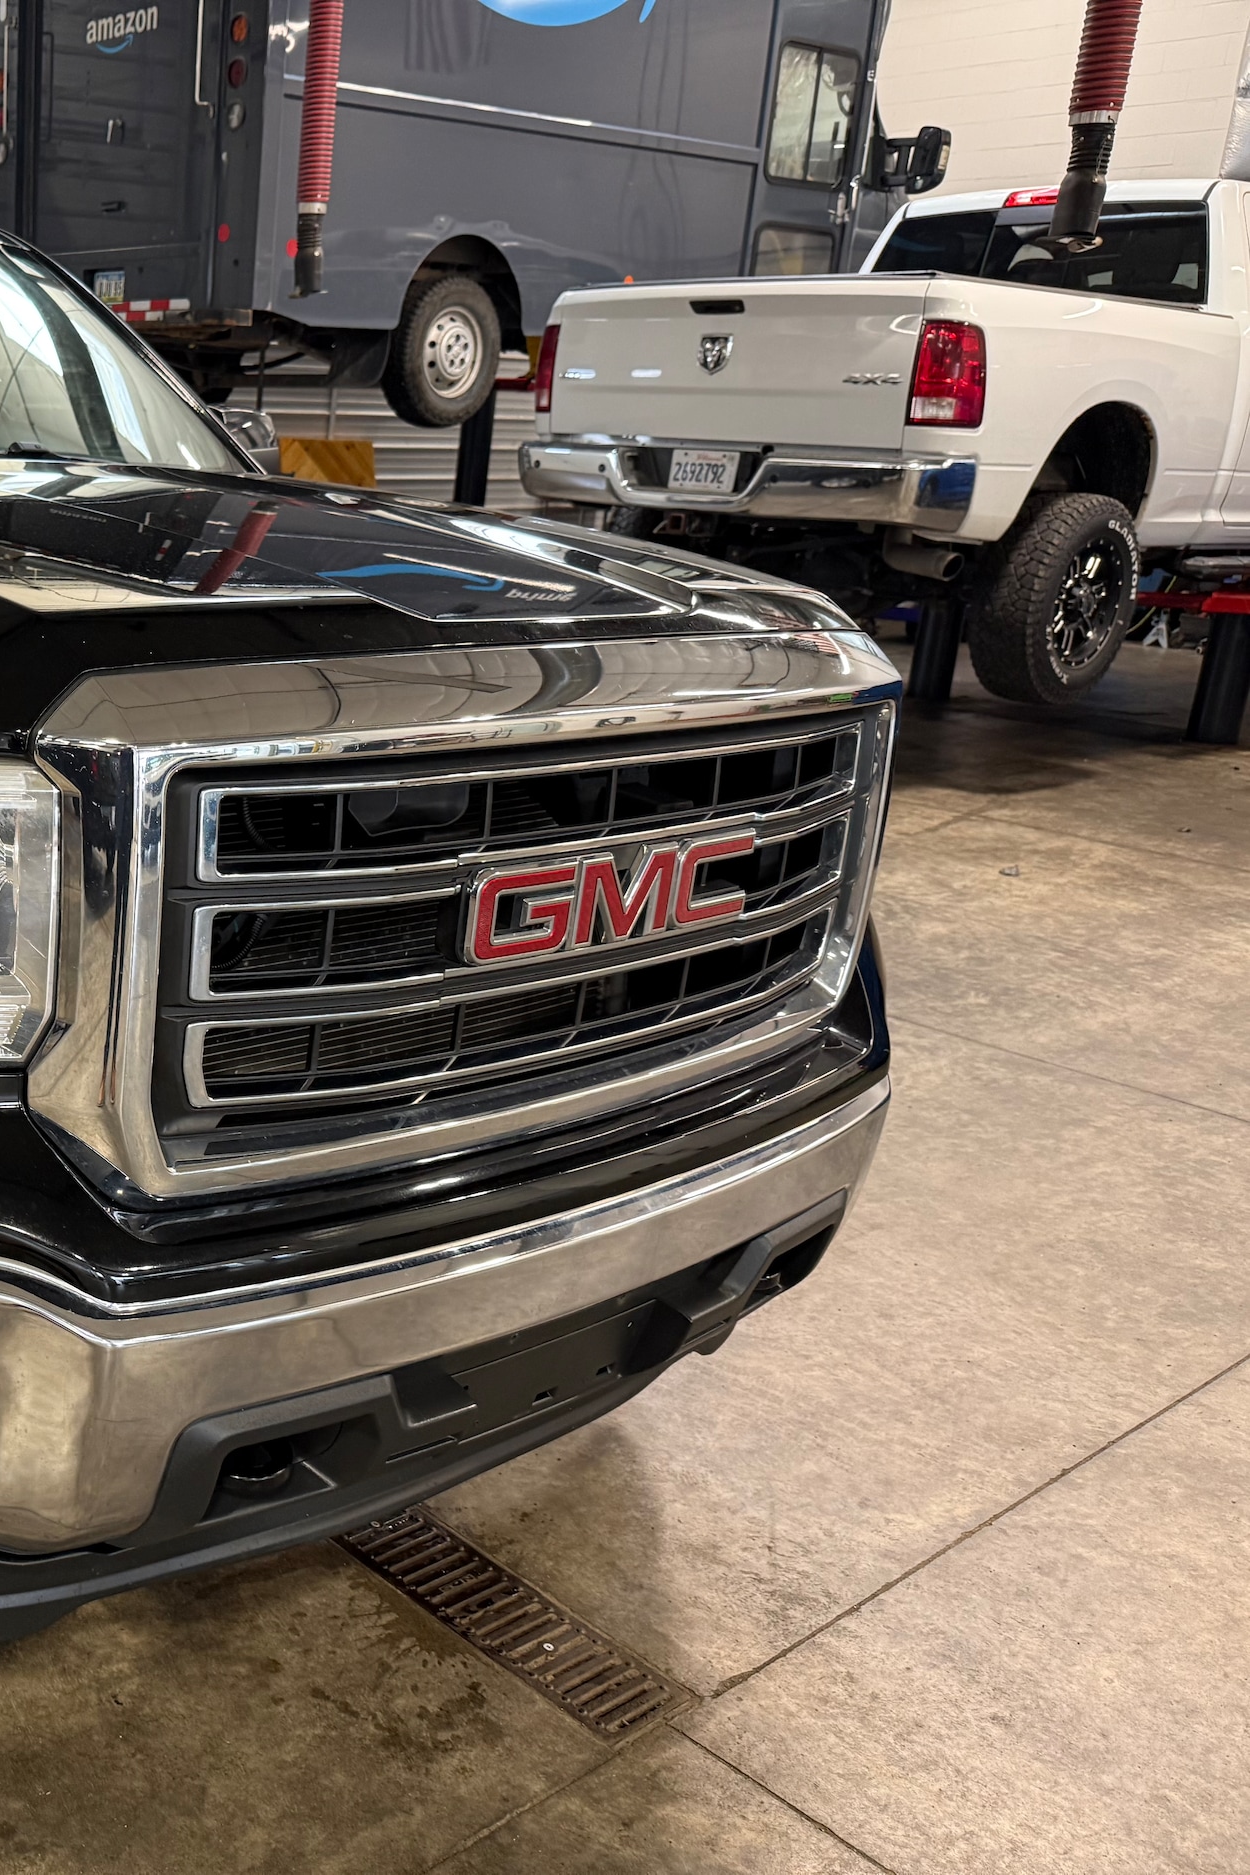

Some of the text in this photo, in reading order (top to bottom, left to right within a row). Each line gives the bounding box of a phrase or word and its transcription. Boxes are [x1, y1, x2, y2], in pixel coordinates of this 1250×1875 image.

[86, 6, 158, 44] amazon
[673, 462, 726, 484] 2692792
[1108, 520, 1138, 600] GLADIATOR
[464, 828, 756, 966] GMC
